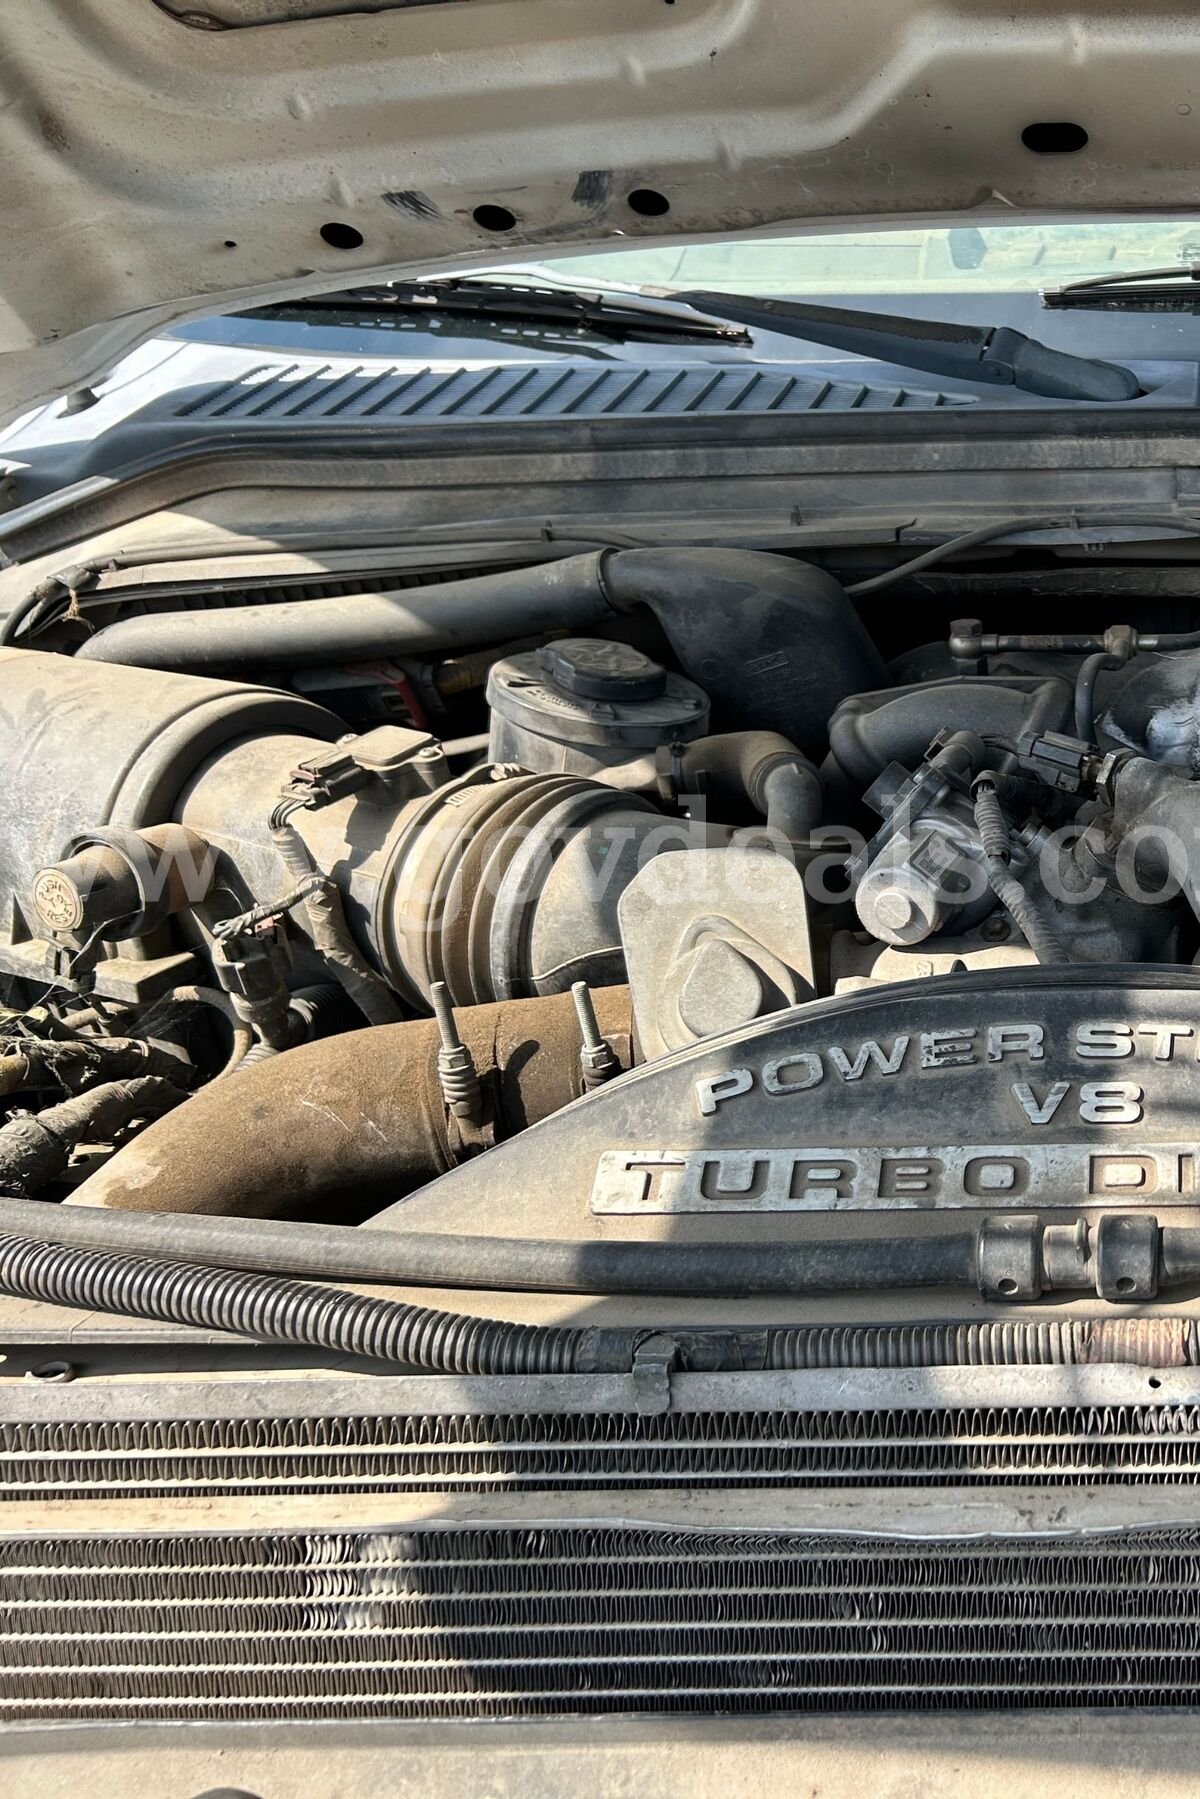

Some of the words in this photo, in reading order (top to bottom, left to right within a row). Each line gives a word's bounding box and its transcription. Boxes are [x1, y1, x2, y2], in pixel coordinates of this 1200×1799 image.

[694, 1023, 1045, 1117] POWER
[1011, 1080, 1146, 1125] V8
[624, 1152, 1032, 1203] TURBO
